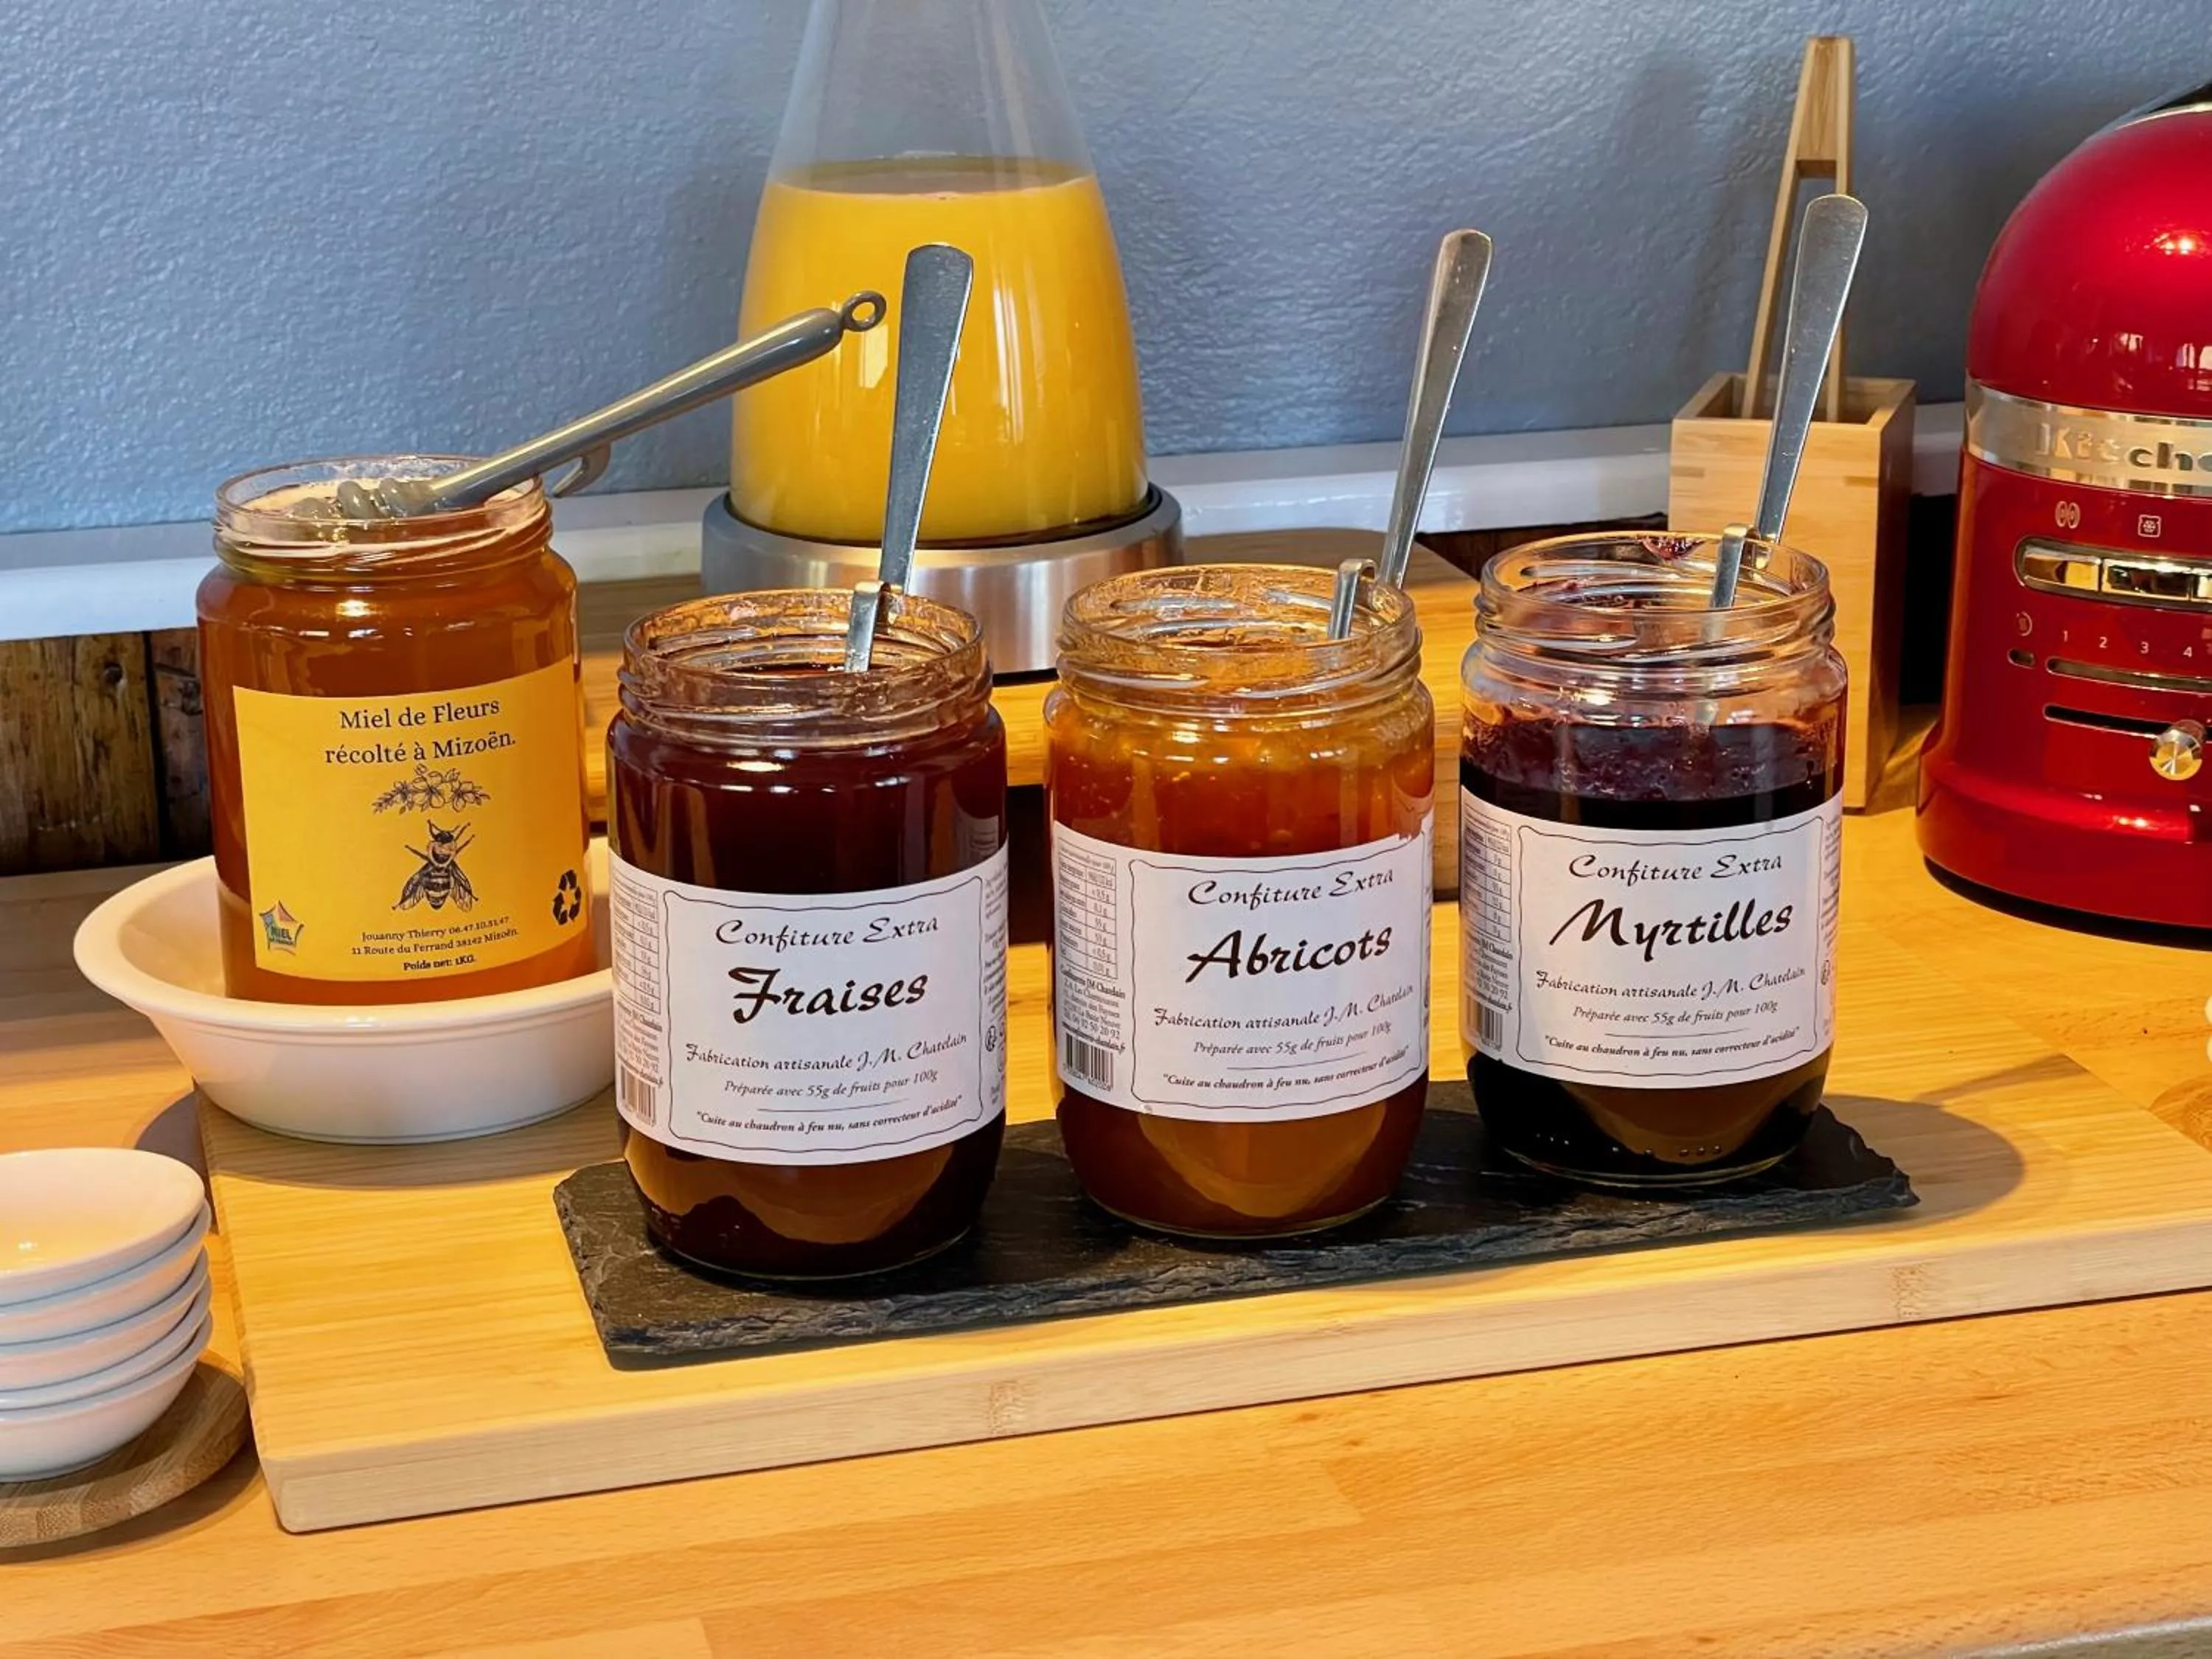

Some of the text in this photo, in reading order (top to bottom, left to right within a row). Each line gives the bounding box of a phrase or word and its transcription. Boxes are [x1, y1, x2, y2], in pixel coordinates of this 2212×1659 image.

[2063, 630, 2193, 658] 1 2 3 4
[339, 700, 499, 728] Miel de Fleurs
[325, 731, 516, 764] récolté à Mizoën.
[1569, 855, 1782, 887] Confiture Extra
[1188, 869, 1393, 911] Confiture Extra
[362, 931, 405, 942] Jouanny
[408, 928, 447, 941] Thierry
[715, 917, 939, 953] Confiture Extra
[1548, 897, 1793, 962] Myrtilles
[364, 945, 394, 955] Route
[397, 944, 411, 953] du
[414, 940, 453, 952] Ferrand
[1186, 927, 1392, 983] Abricots
[403, 959, 431, 970] Poids
[728, 967, 928, 1023] Fraises
[1536, 970, 1617, 996] Fabrication
[1621, 984, 1697, 997] artisanale
[1701, 978, 1743, 1001] J.M.
[1749, 967, 1806, 990] Chatelain
[1154, 1008, 1241, 1029] Fabrication
[1245, 1010, 1320, 1029] artisanale
[1323, 1002, 1363, 1027] J.M.
[1573, 1000, 1778, 1026] Préparée avec 55g de fruits pour 100g
[686, 1043, 769, 1069] Fabrication
[773, 1055, 852, 1070] artisanale
[857, 1048, 902, 1071] J.M.
[907, 1032, 967, 1060] Chatelain
[1194, 1041, 1243, 1057] Préparée
[1246, 1046, 1272, 1054] avec
[1276, 1042, 1298, 1055] 55g
[1301, 1038, 1313, 1051] de
[1314, 1035, 1344, 1052] fruits
[1346, 1030, 1369, 1047] pour
[1591, 1043, 1640, 1056] chaudron
[1643, 1047, 1649, 1056] à
[1649, 1046, 1669, 1059] feu
[1691, 1047, 1713, 1056] sans
[1714, 1040, 1761, 1054] correcteur
[725, 1069, 939, 1099] Préparée avec 55g de fruits pour 100g
[1214, 1078, 1263, 1089] chaudron
[1266, 1078, 1273, 1088] à
[1273, 1077, 1292, 1091] feu
[1314, 1076, 1334, 1084] sans
[1336, 1062, 1377, 1079] correcteur
[744, 1119, 795, 1132] chaudron
[797, 1121, 805, 1132] à
[805, 1121, 825, 1134] feu
[848, 1121, 871, 1129] sans
[872, 1111, 920, 1127] correcteur
